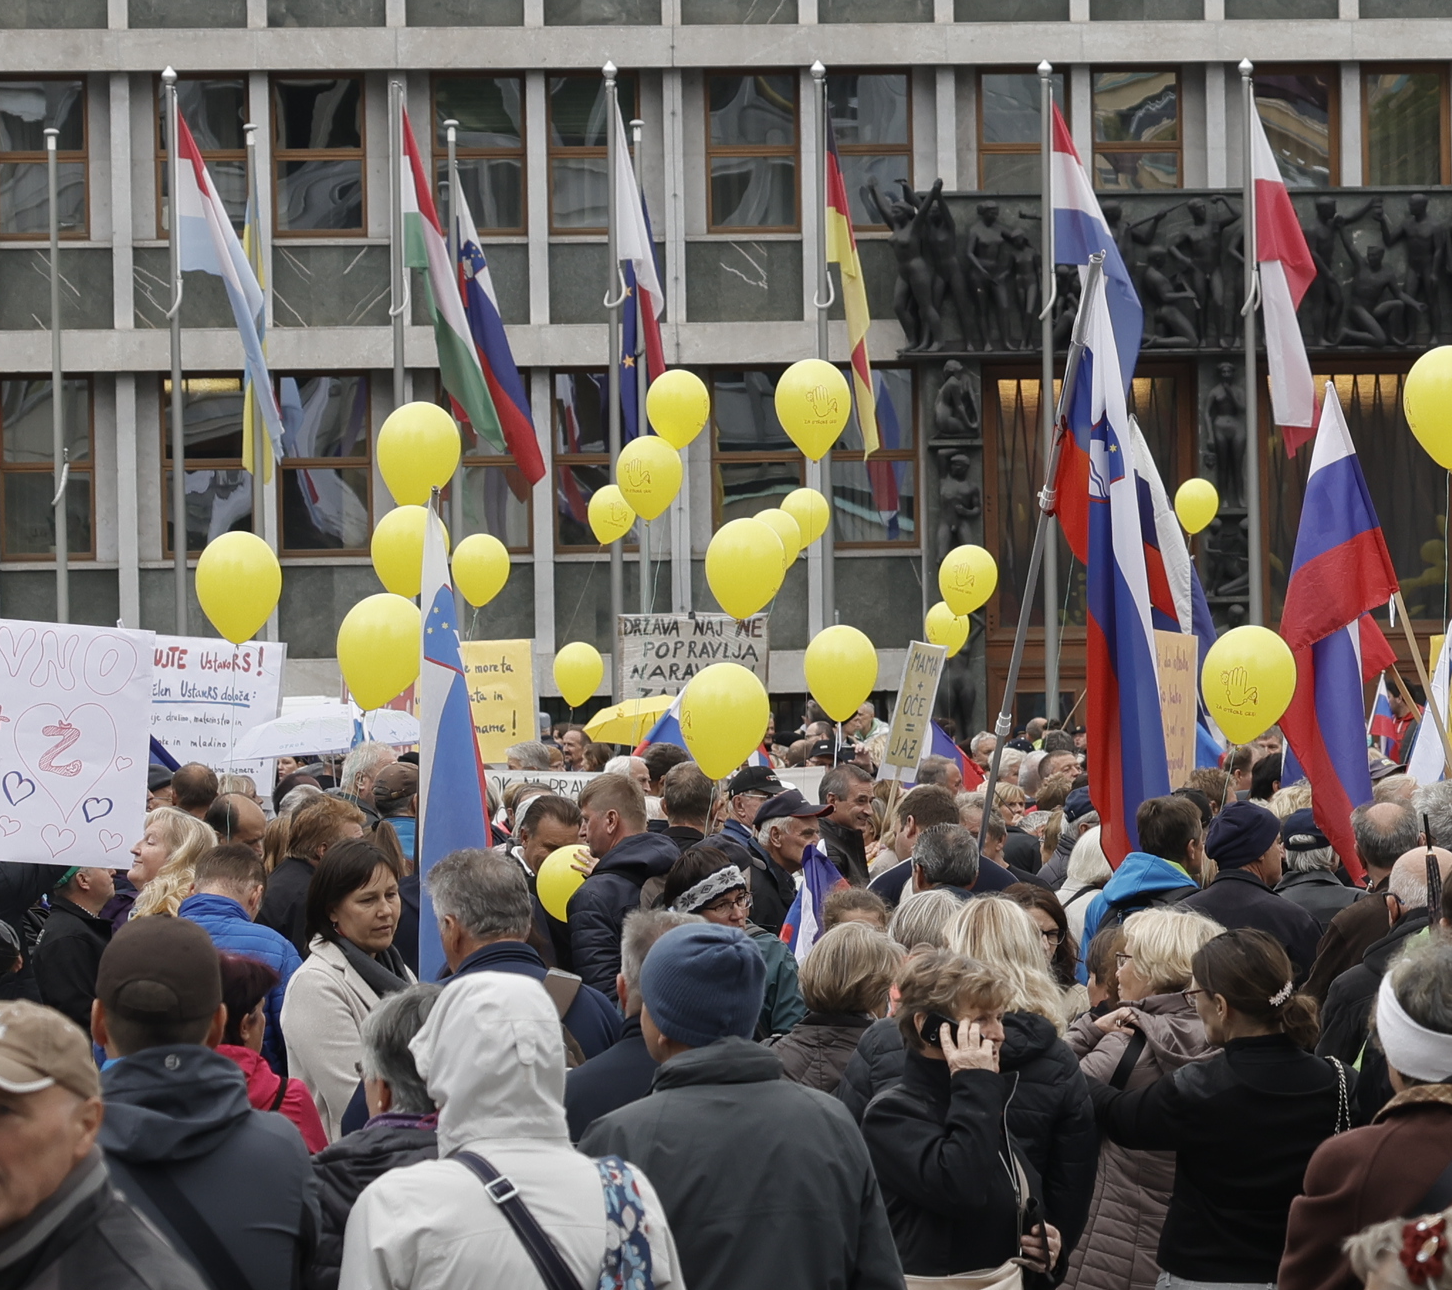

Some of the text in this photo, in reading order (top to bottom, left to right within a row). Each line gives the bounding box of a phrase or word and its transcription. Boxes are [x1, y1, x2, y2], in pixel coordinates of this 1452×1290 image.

[735, 618, 763, 639] NE
[643, 640, 759, 662] POPRAVLJA
[911, 652, 938, 677] MAMA
[38, 719, 81, 777] Ž
